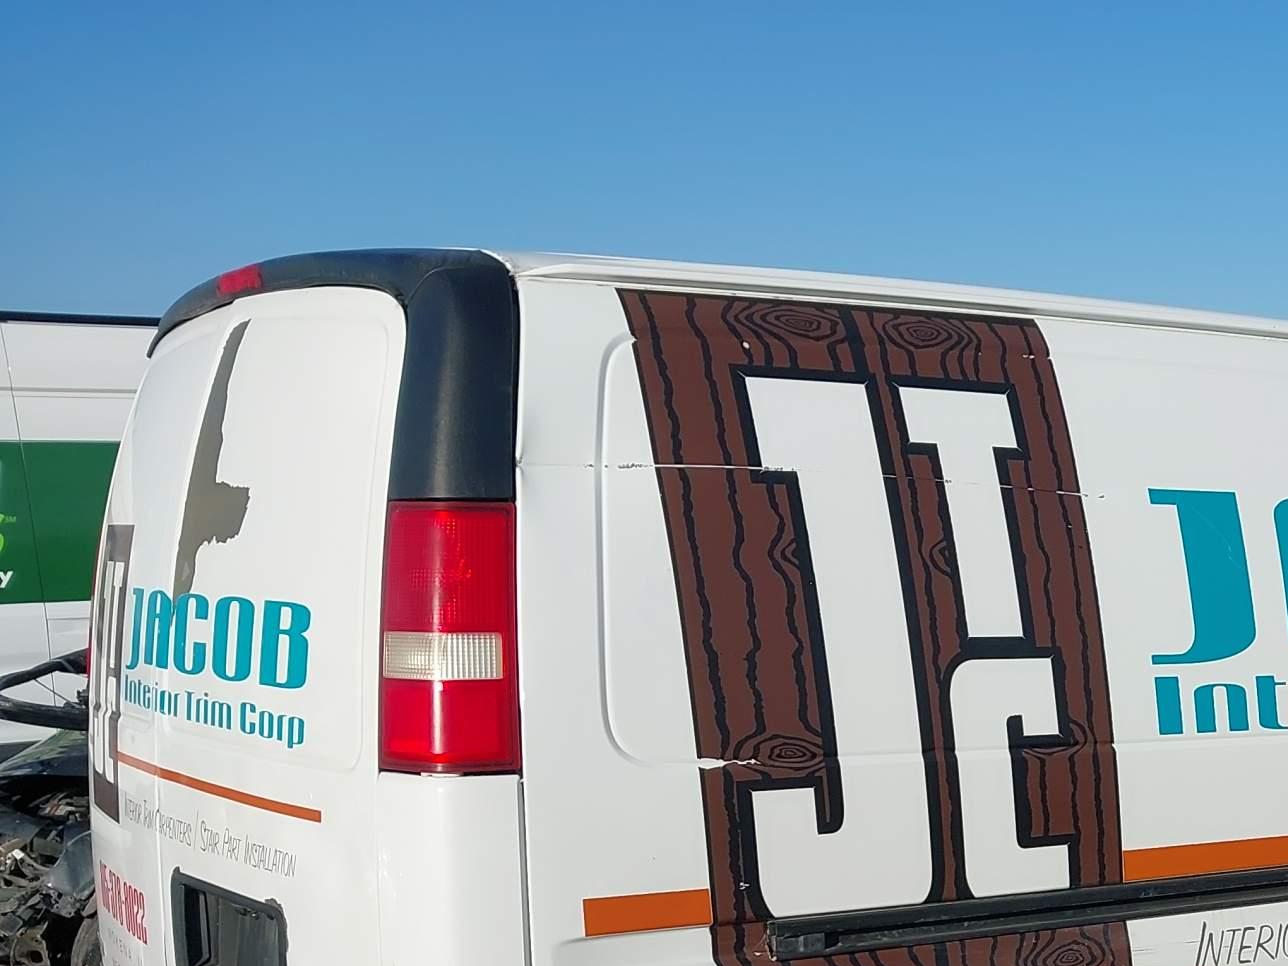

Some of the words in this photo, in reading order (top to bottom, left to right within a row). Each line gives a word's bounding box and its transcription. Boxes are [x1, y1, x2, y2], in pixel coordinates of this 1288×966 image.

[125, 587, 312, 689] JACOB
[124, 674, 181, 718] Interior
[184, 689, 233, 731] Trim
[240, 701, 305, 749] Corp
[199, 819, 220, 852] STAIR
[221, 827, 242, 862] PART
[244, 834, 297, 878] INSTALLATION
